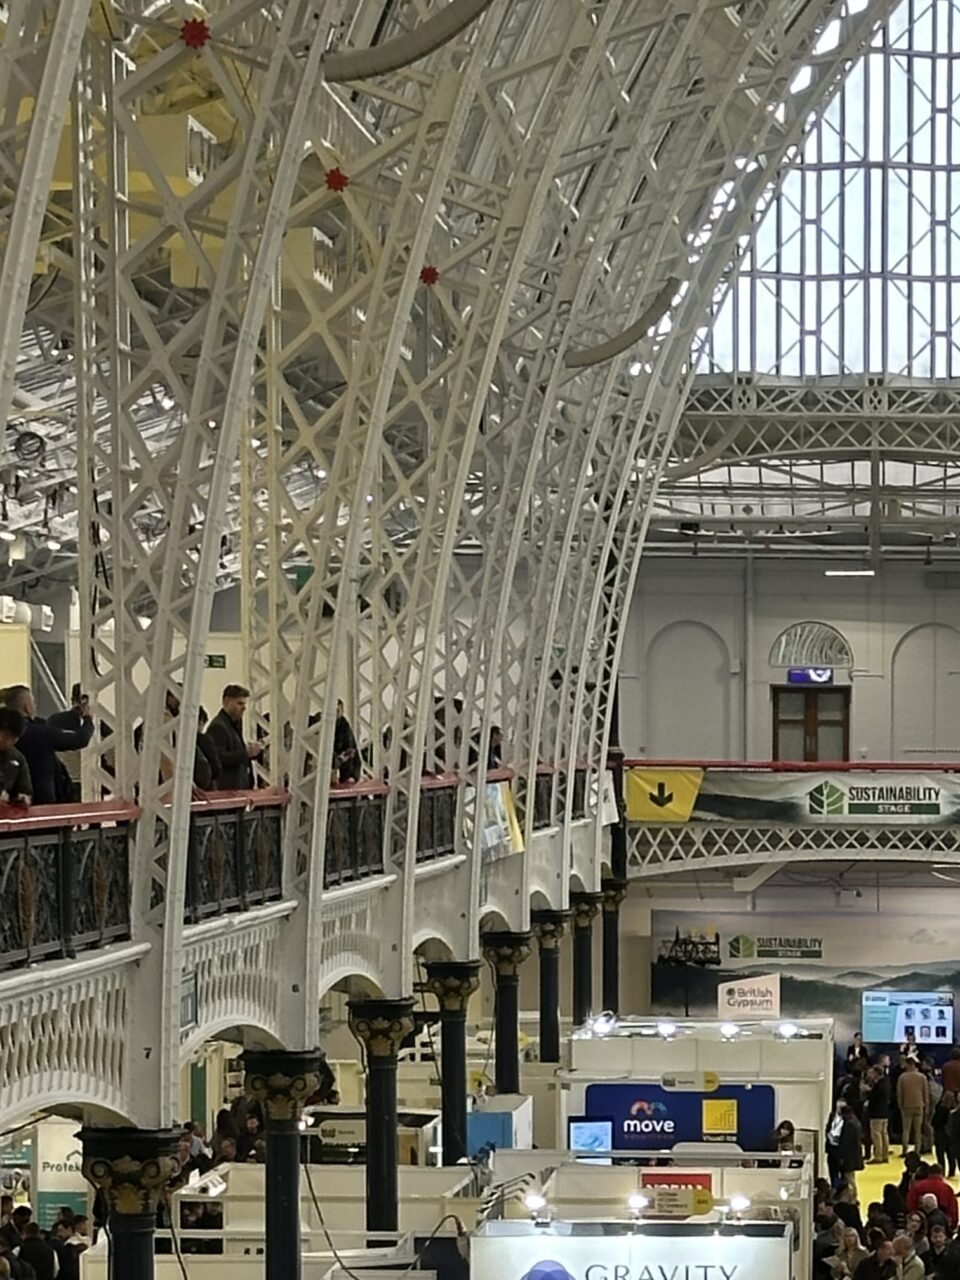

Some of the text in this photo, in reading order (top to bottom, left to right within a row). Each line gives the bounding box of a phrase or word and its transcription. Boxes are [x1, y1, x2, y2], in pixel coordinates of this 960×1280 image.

[849, 785, 941, 801] SUSTAINABILITY
[877, 804, 912, 813] STAGE
[757, 937, 823, 949] SUSTAINABILITY
[737, 987, 774, 998] British
[726, 997, 774, 1008] Gypsum
[623, 1119, 675, 1133] move
